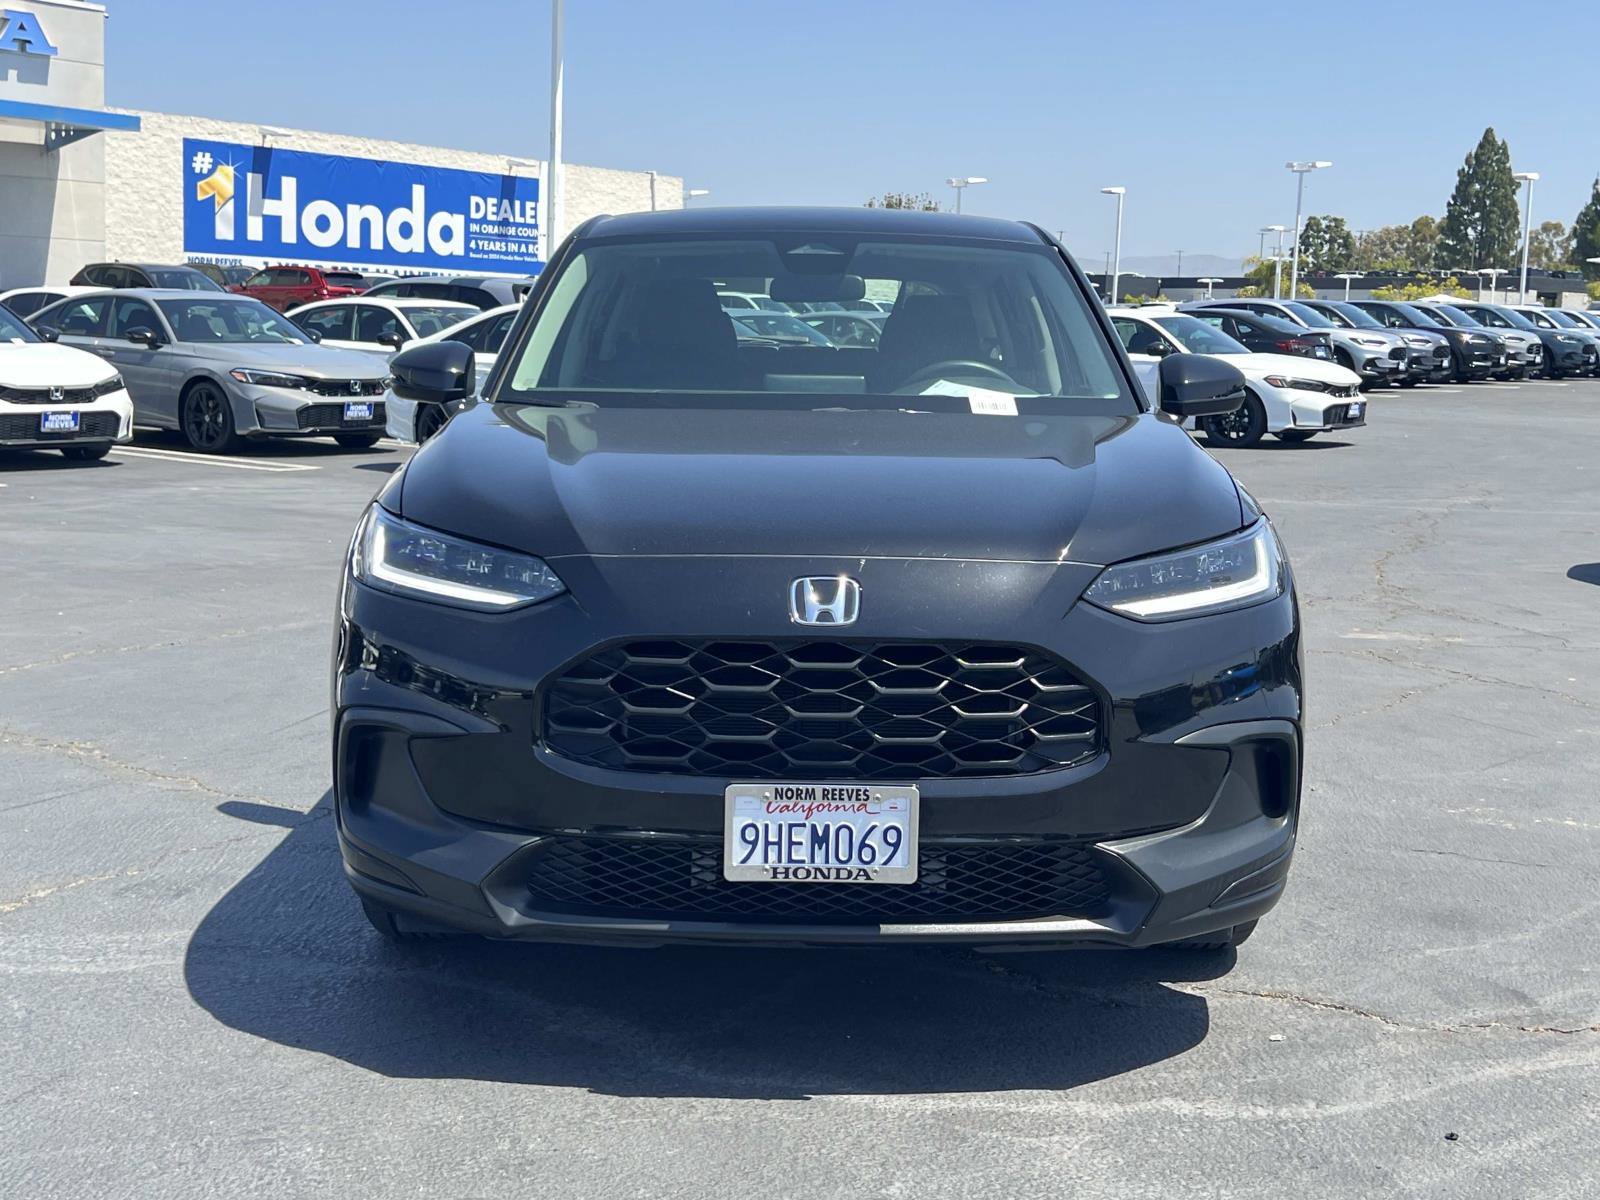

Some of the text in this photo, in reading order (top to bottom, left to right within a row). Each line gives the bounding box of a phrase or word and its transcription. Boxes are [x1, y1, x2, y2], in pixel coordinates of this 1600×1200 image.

[247, 172, 465, 256] Honda
[470, 195, 540, 224] DEALE
[470, 222, 480, 233] IN
[481, 224, 516, 235] ORANGE
[469, 239, 476, 250] 4
[477, 240, 506, 252] YEARS
[507, 242, 519, 253] IN
[519, 243, 527, 254] A
[774, 787, 870, 802] NORM REEVES
[766, 800, 881, 820] California
[739, 821, 904, 866] 9HEM069
[770, 866, 875, 881] HONDA
